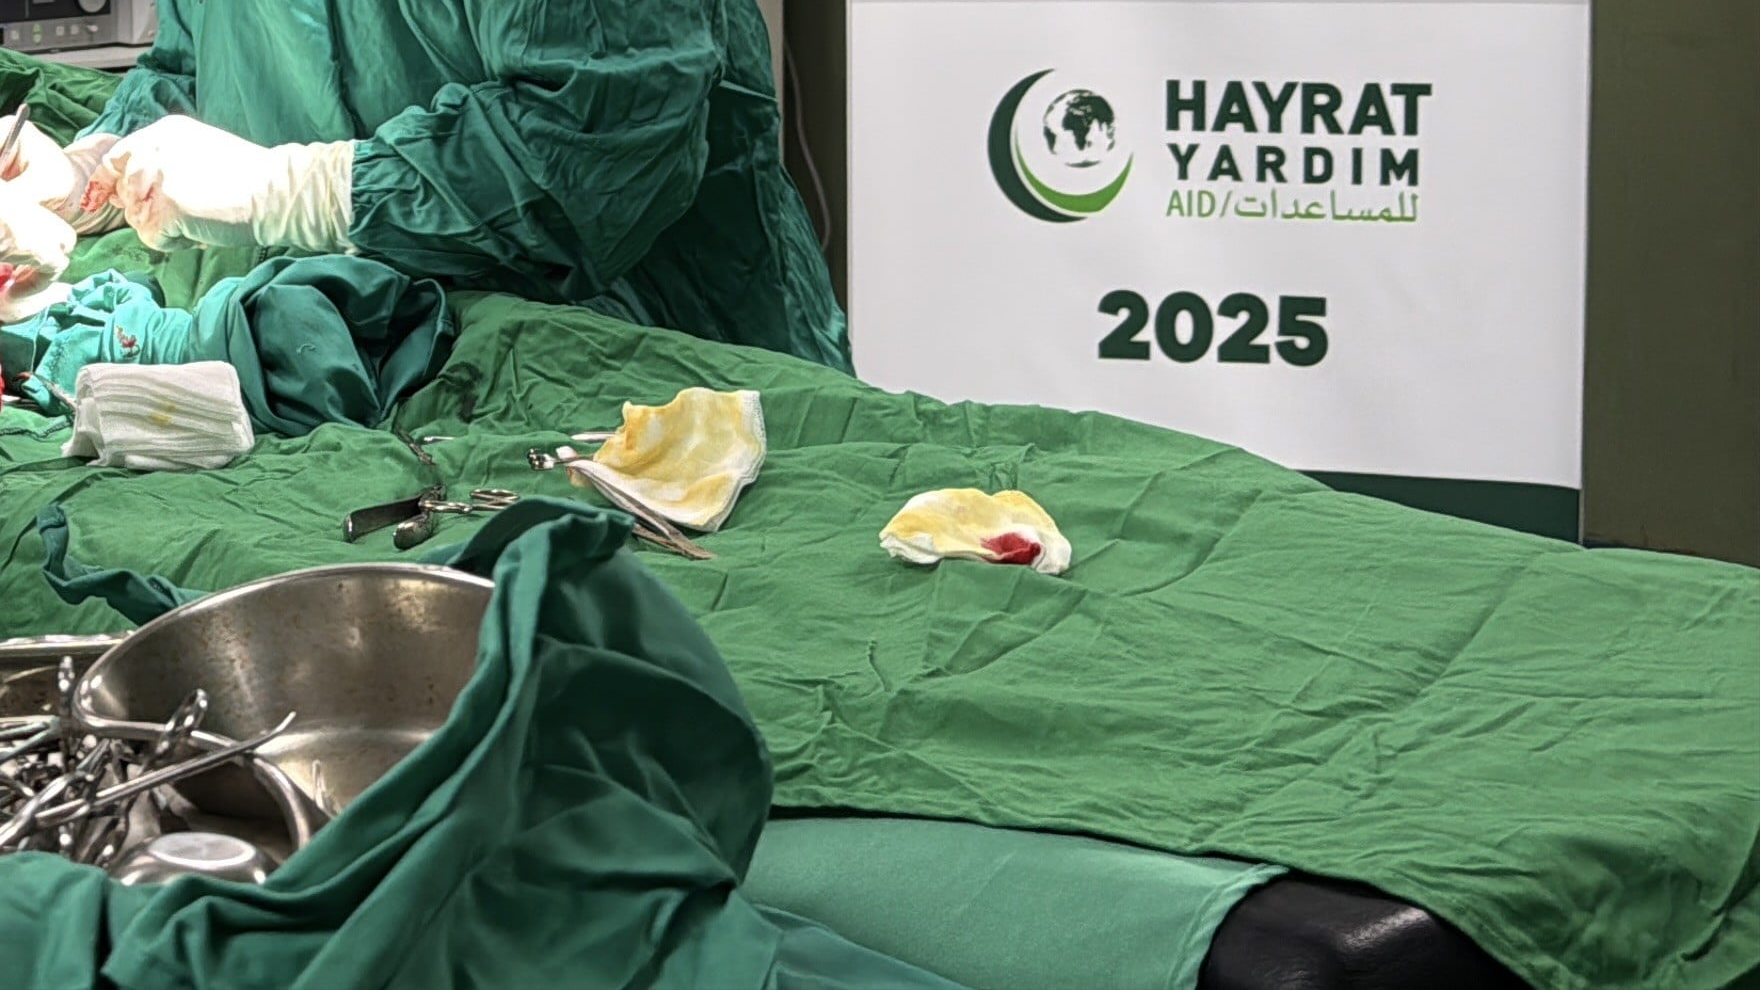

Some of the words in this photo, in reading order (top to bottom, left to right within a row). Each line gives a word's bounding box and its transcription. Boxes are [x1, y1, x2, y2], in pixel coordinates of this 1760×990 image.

[1166, 79, 1433, 136] HAYRAT
[1167, 143, 1420, 187] YARDIM
[1097, 289, 1329, 367] 2025
